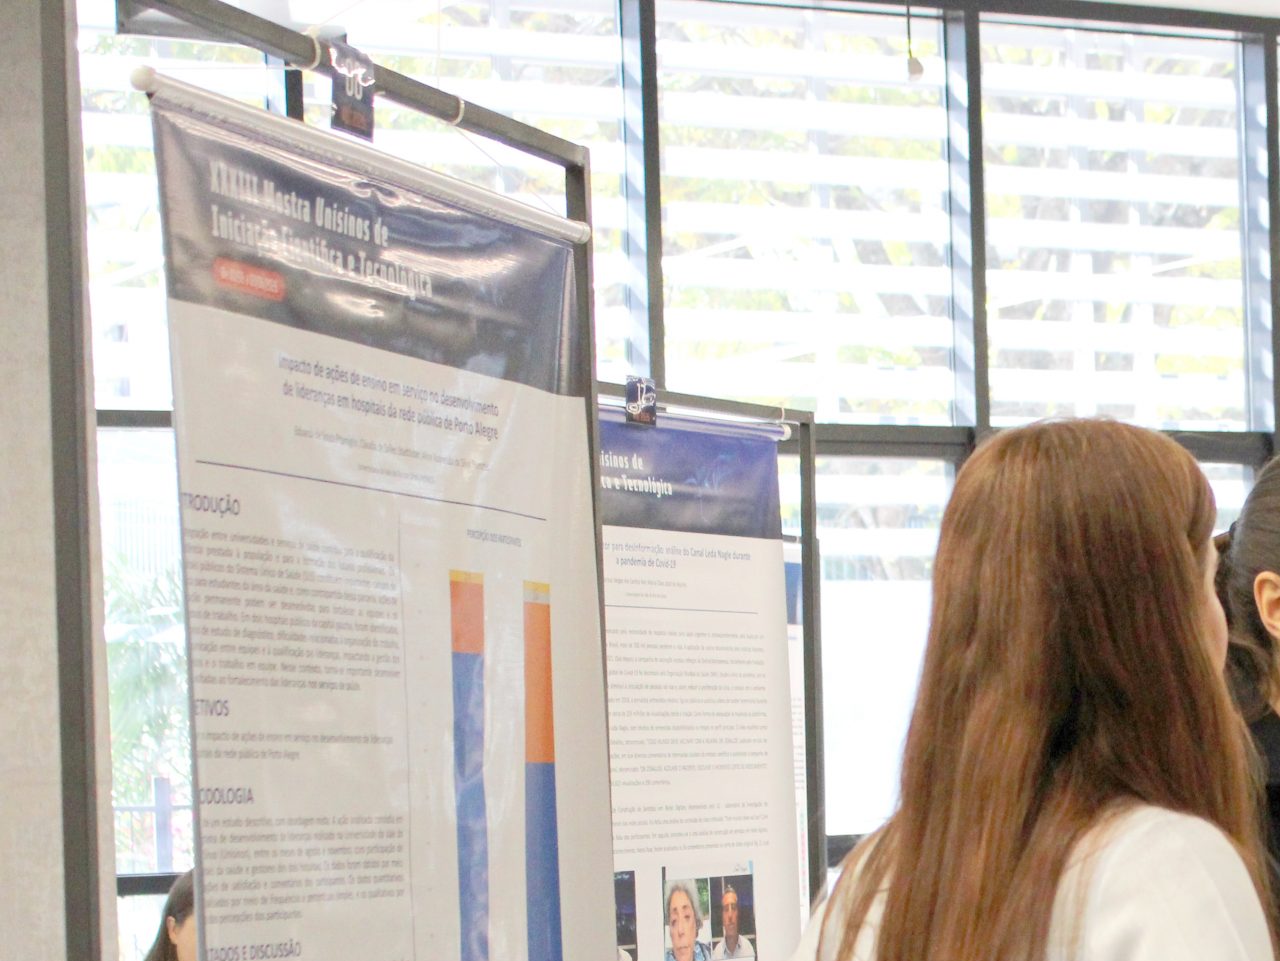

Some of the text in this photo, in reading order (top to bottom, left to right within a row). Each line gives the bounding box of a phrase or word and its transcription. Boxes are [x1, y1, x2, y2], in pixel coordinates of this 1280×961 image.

[263, 179, 311, 223] Mostra
[315, 196, 370, 242] Unisinos
[374, 217, 389, 248] de
[314, 360, 324, 378] de
[325, 364, 348, 384] ações
[350, 369, 361, 387] de
[362, 374, 388, 393] ensino
[388, 381, 401, 395] em
[429, 390, 440, 404] no
[283, 379, 294, 397] de
[337, 394, 350, 409] em
[387, 401, 398, 420] da
[399, 406, 416, 423] rede
[443, 415, 454, 431] de
[454, 416, 474, 436] Porto
[475, 421, 499, 442] Alegre
[632, 453, 645, 471] de
[614, 477, 621, 490] e
[621, 474, 673, 498] Tecnológica
[621, 555, 647, 568] pandemia
[648, 557, 655, 568] de
